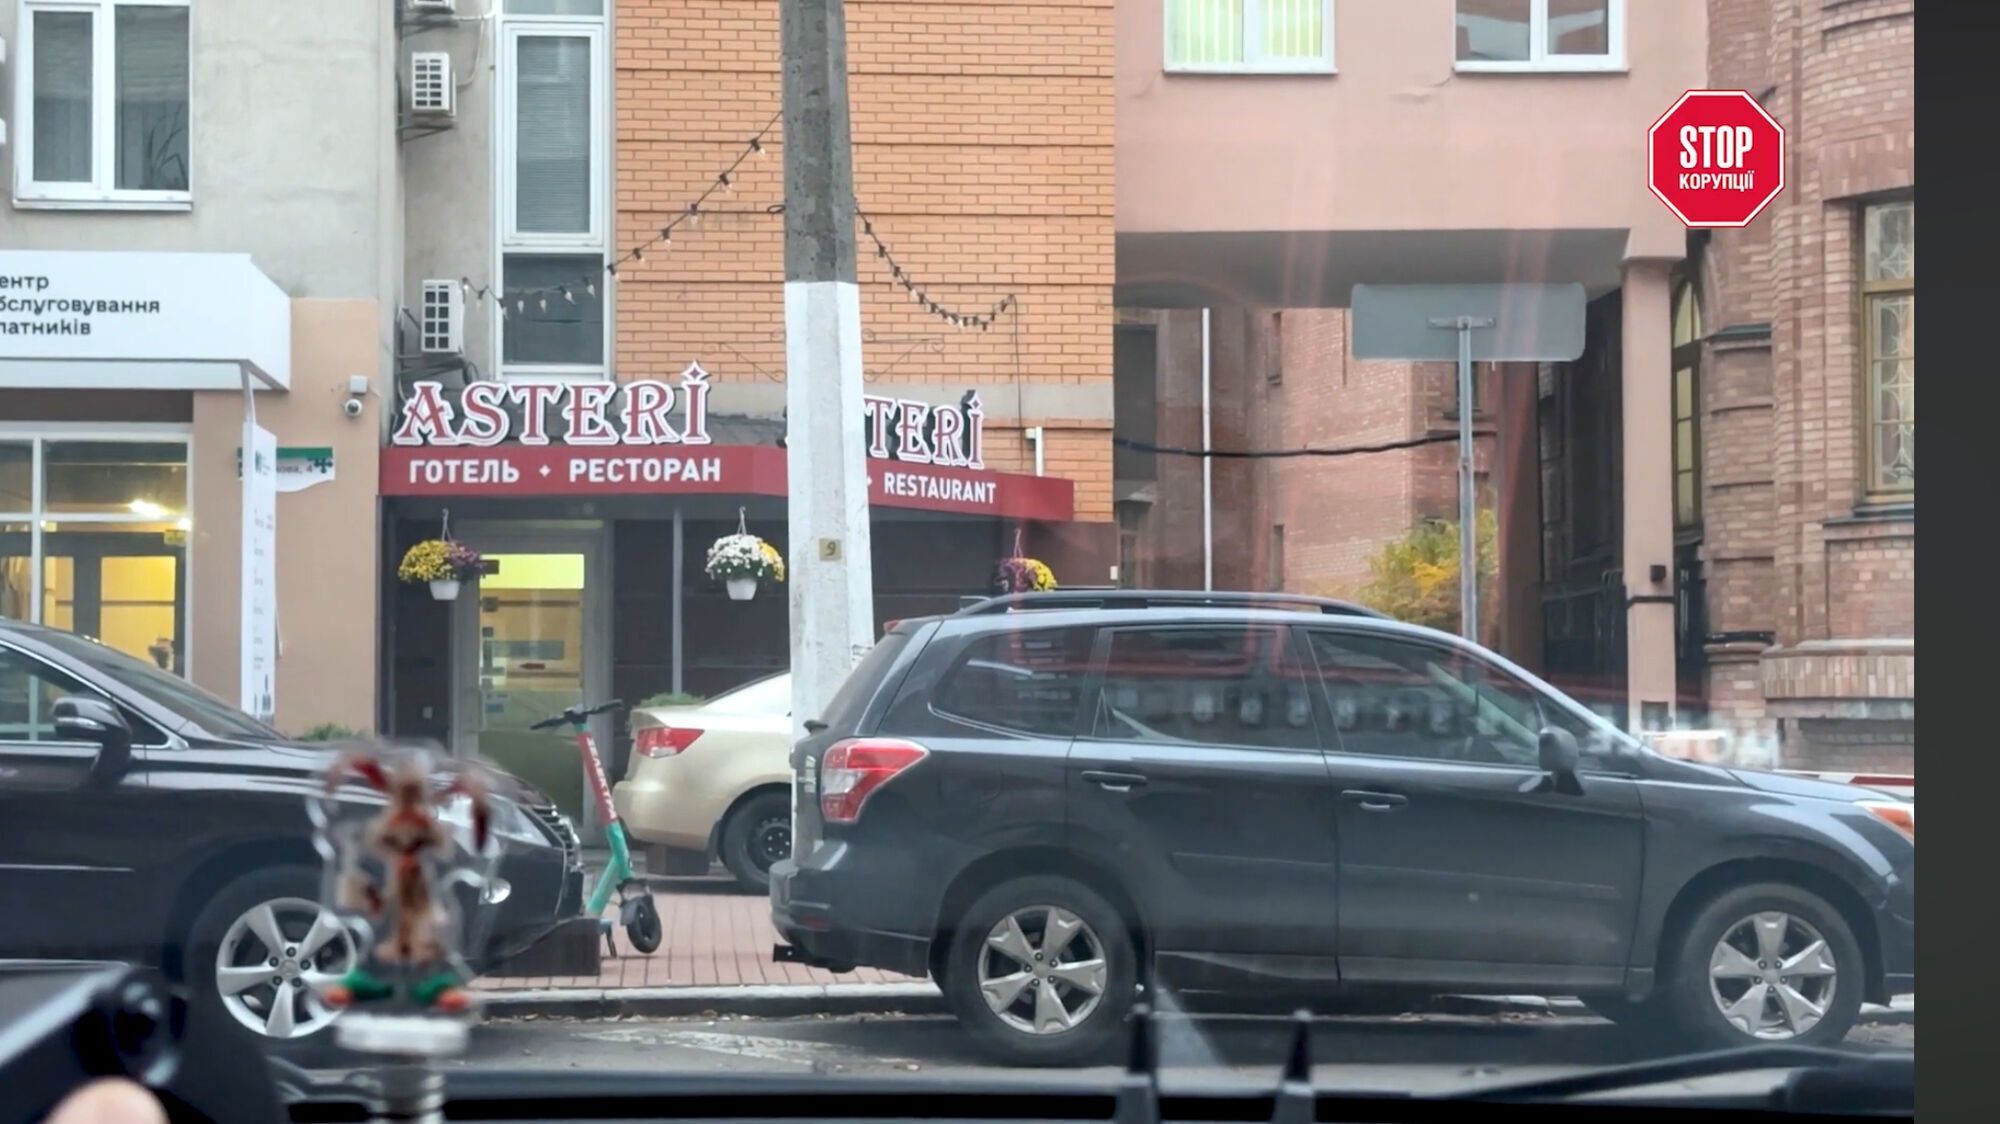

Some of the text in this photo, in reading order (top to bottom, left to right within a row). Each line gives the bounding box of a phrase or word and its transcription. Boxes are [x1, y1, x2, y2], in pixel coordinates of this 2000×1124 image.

[862, 391, 984, 470] TERI
[409, 457, 722, 484] ГОТЕЛЬ РЕСТОРАН
[883, 471, 997, 504] RESTAURANT
